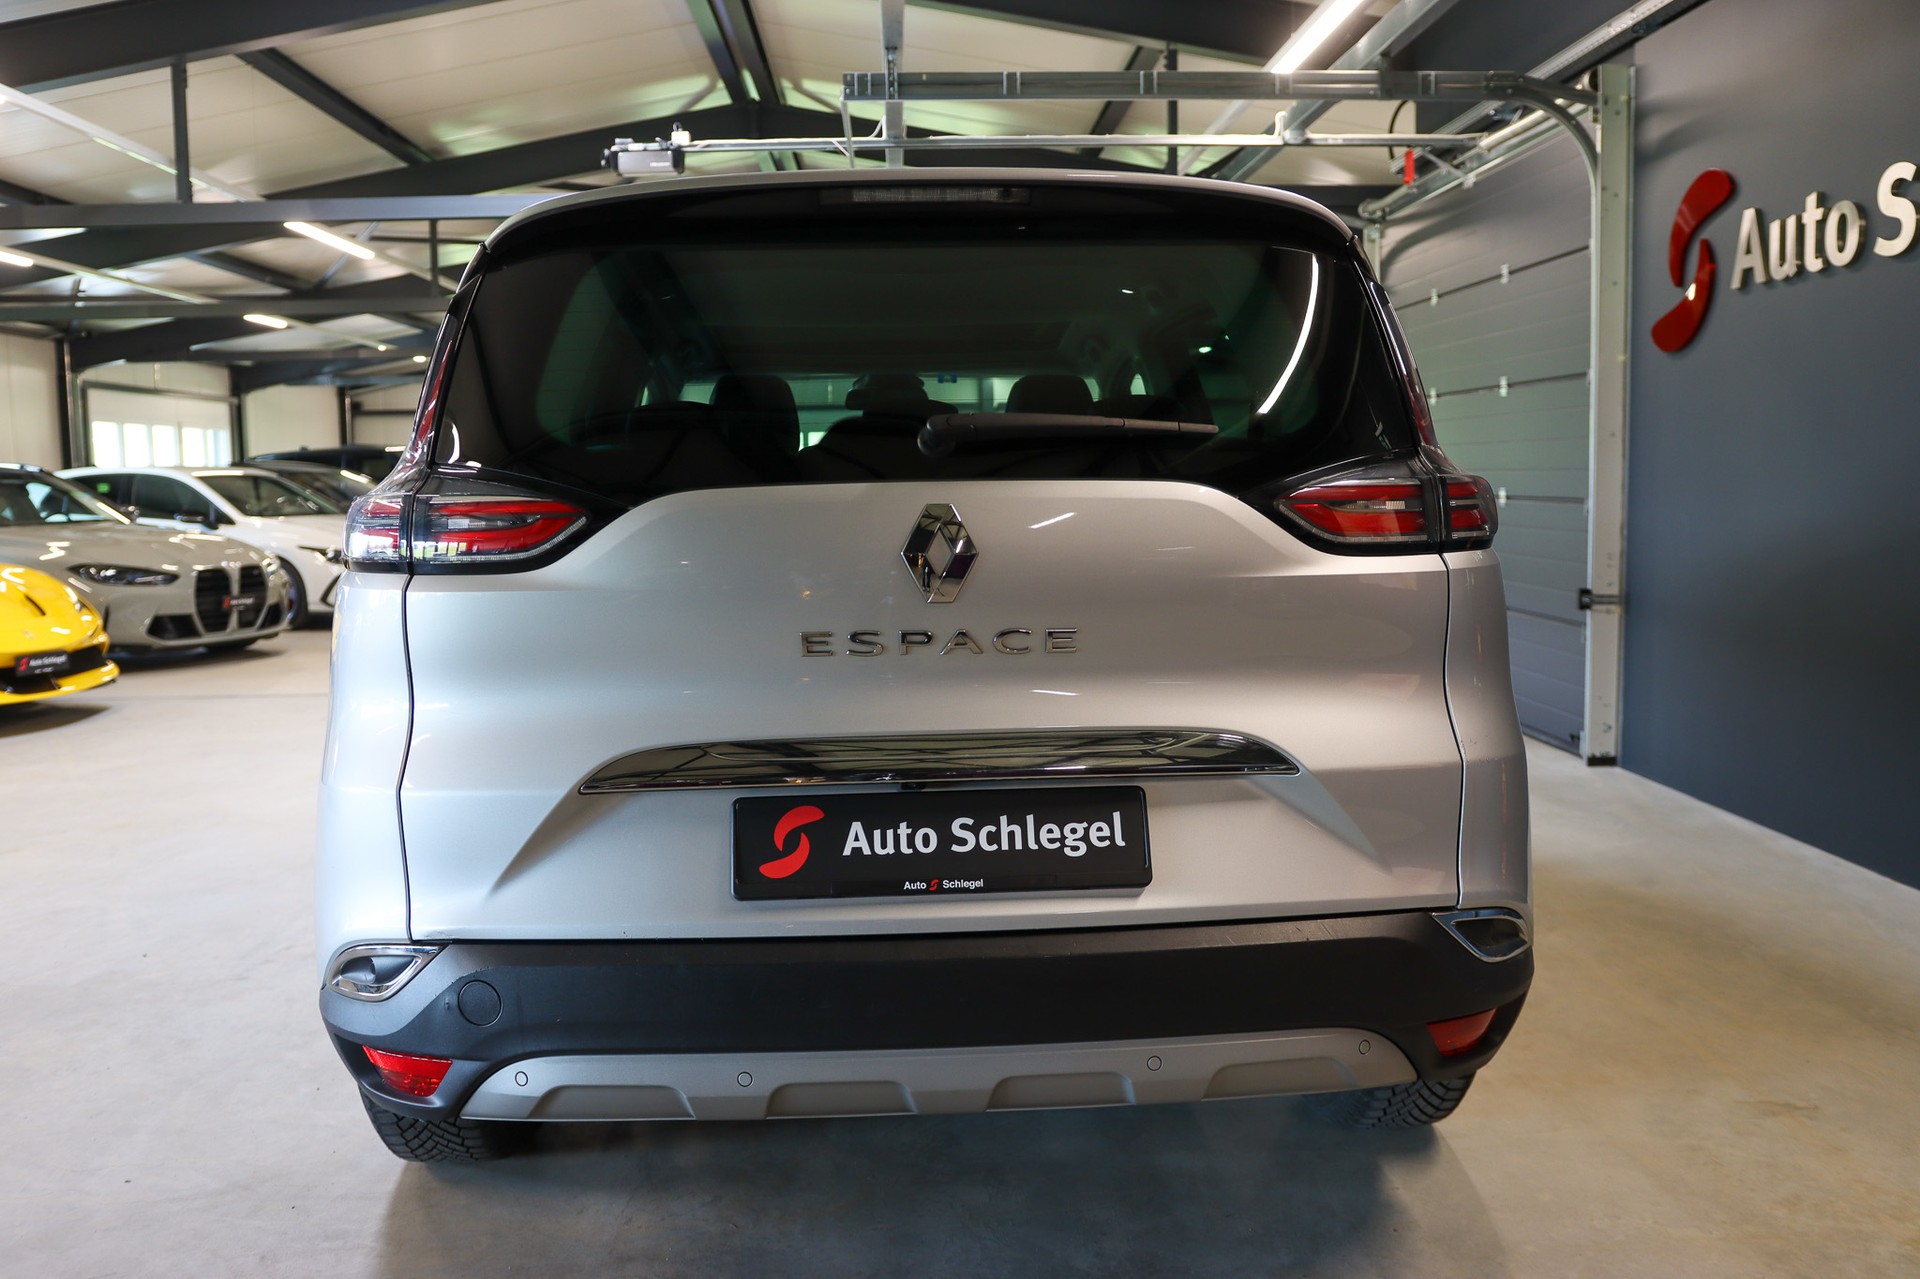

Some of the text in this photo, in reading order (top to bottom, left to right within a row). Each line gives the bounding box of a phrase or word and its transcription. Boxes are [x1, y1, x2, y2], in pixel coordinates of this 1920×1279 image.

[1730, 191, 1861, 290] Auto
[800, 628, 1078, 657] ESPACE
[843, 811, 1126, 857] Auto Schlegel
[903, 878, 984, 890] Auto Schlegel
